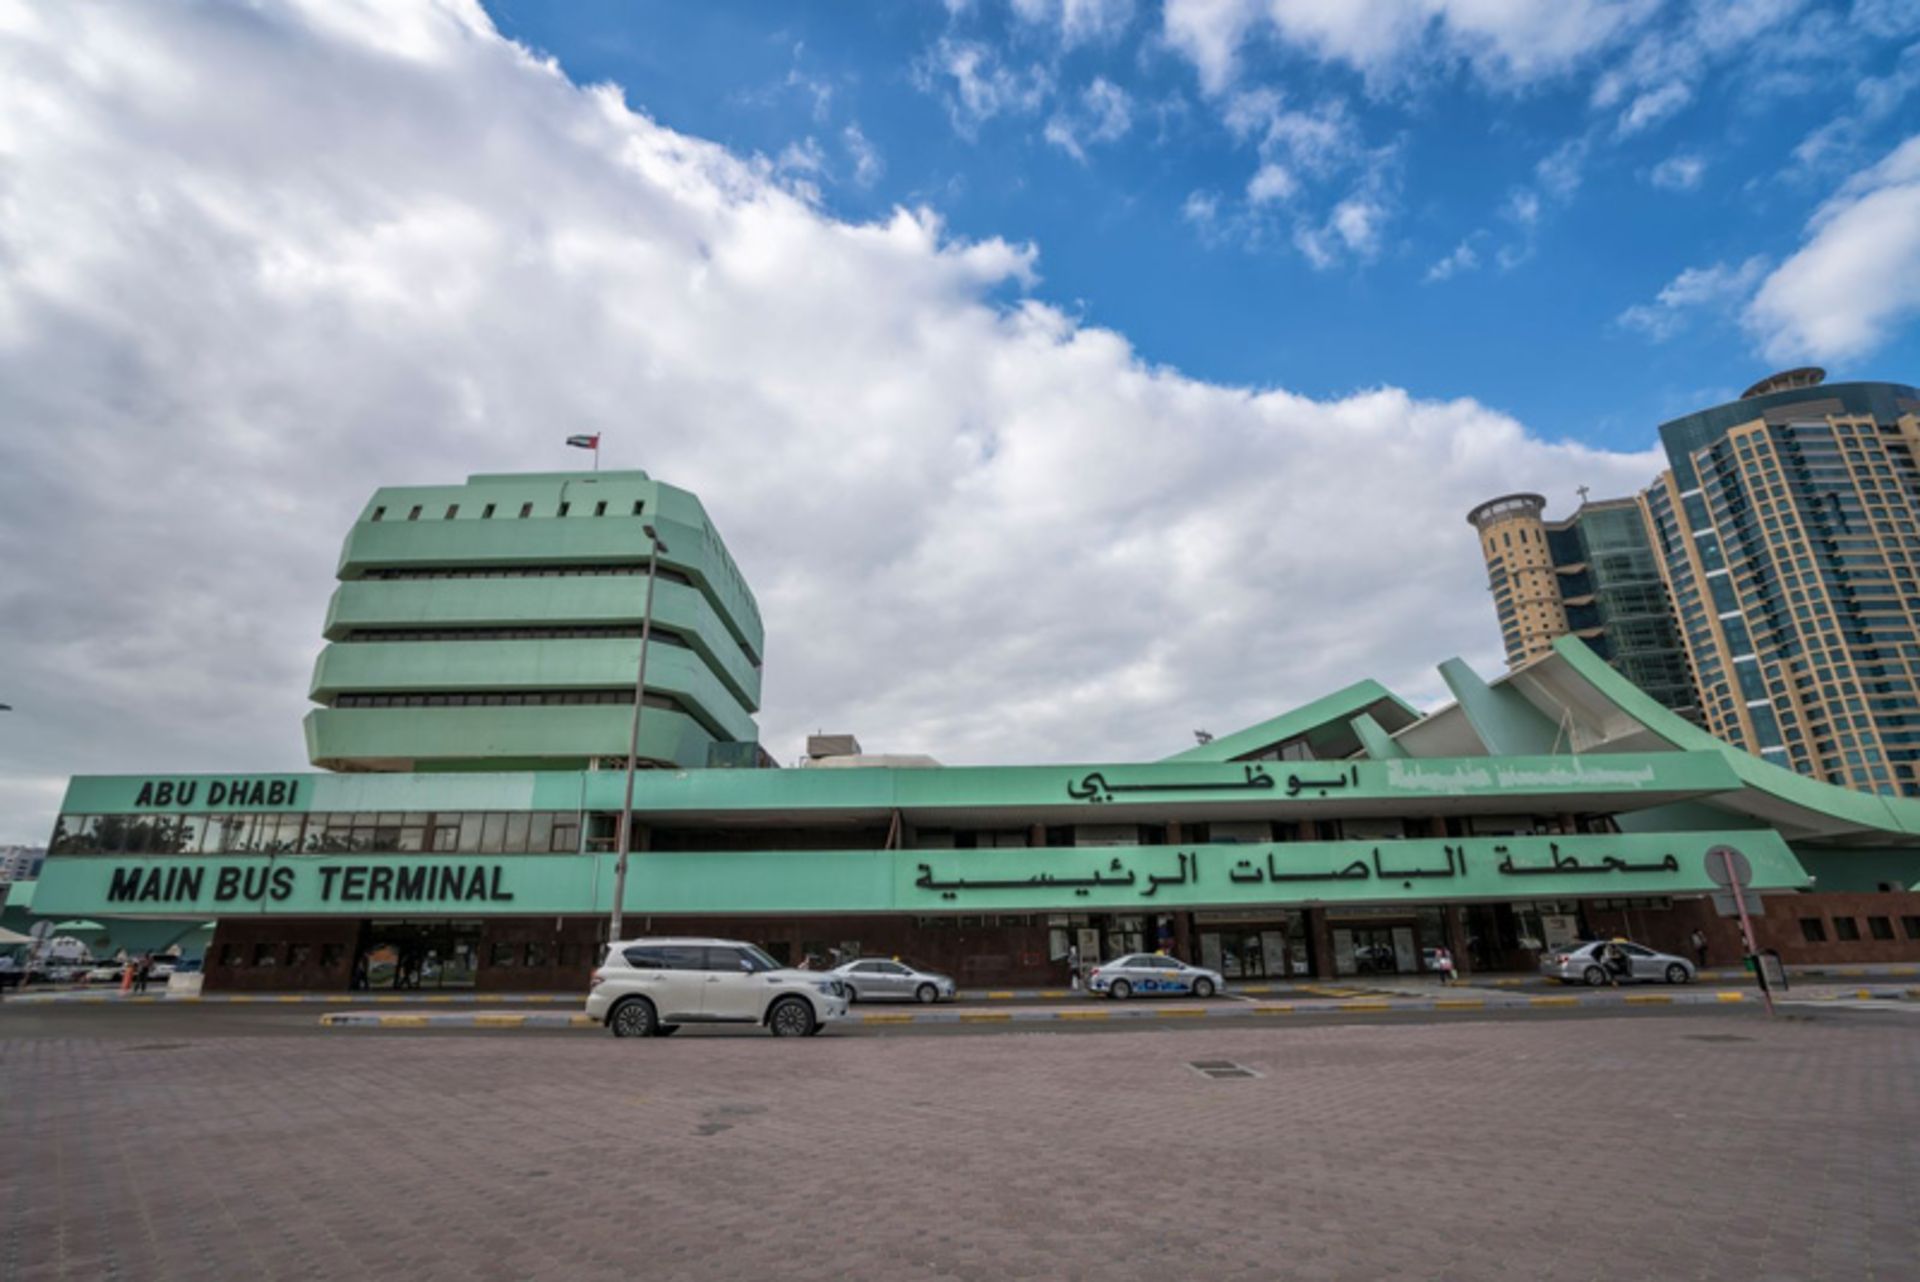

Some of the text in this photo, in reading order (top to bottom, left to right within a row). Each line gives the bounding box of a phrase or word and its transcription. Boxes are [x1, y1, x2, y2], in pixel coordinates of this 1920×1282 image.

[135, 779, 299, 808] ABU DHABI
[107, 865, 514, 903] MAIN BUS TERMINAL
[915, 842, 1680, 900] محطة الباصات الرئيسية
